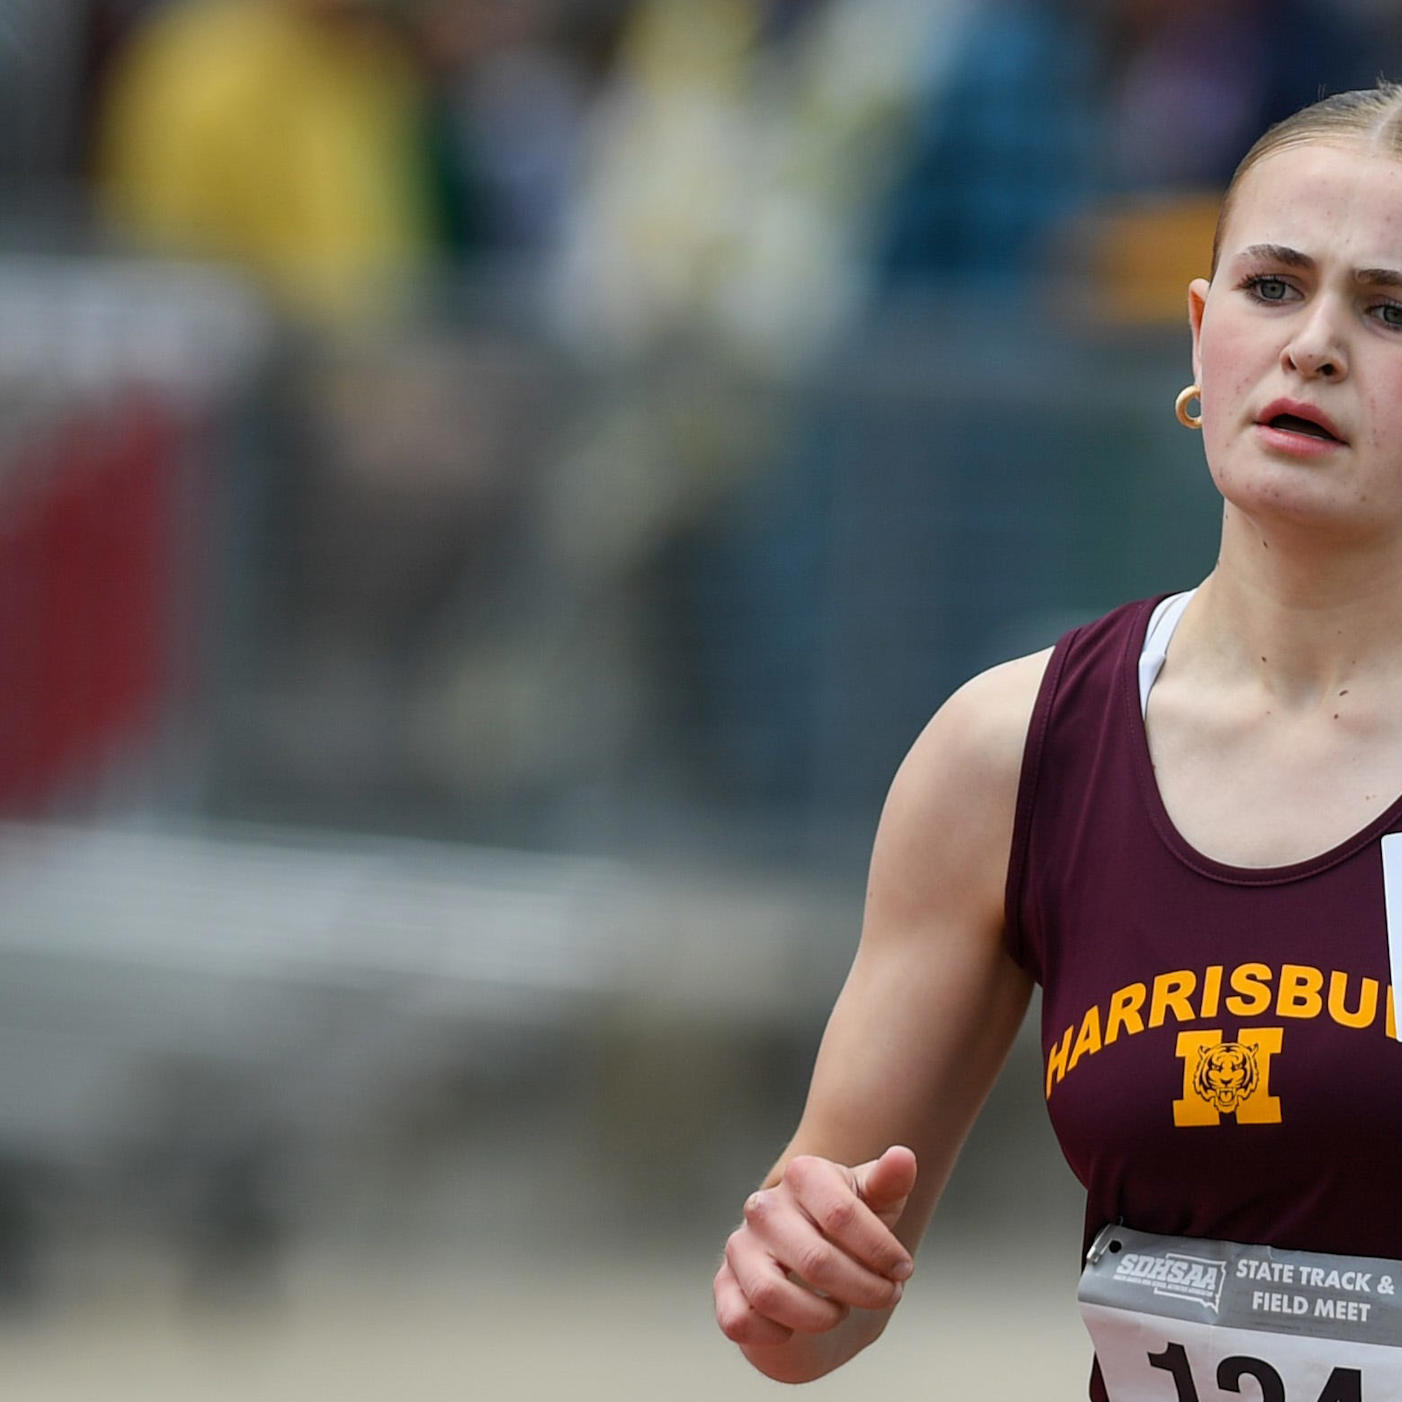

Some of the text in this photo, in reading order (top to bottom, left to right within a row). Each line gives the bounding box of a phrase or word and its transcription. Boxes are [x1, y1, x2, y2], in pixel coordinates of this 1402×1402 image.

[1116, 1253, 1219, 1290] SDHSAA
[1236, 1259, 1395, 1296] STATE TRACK &
[1252, 1291, 1372, 1322] FIELD MEET
